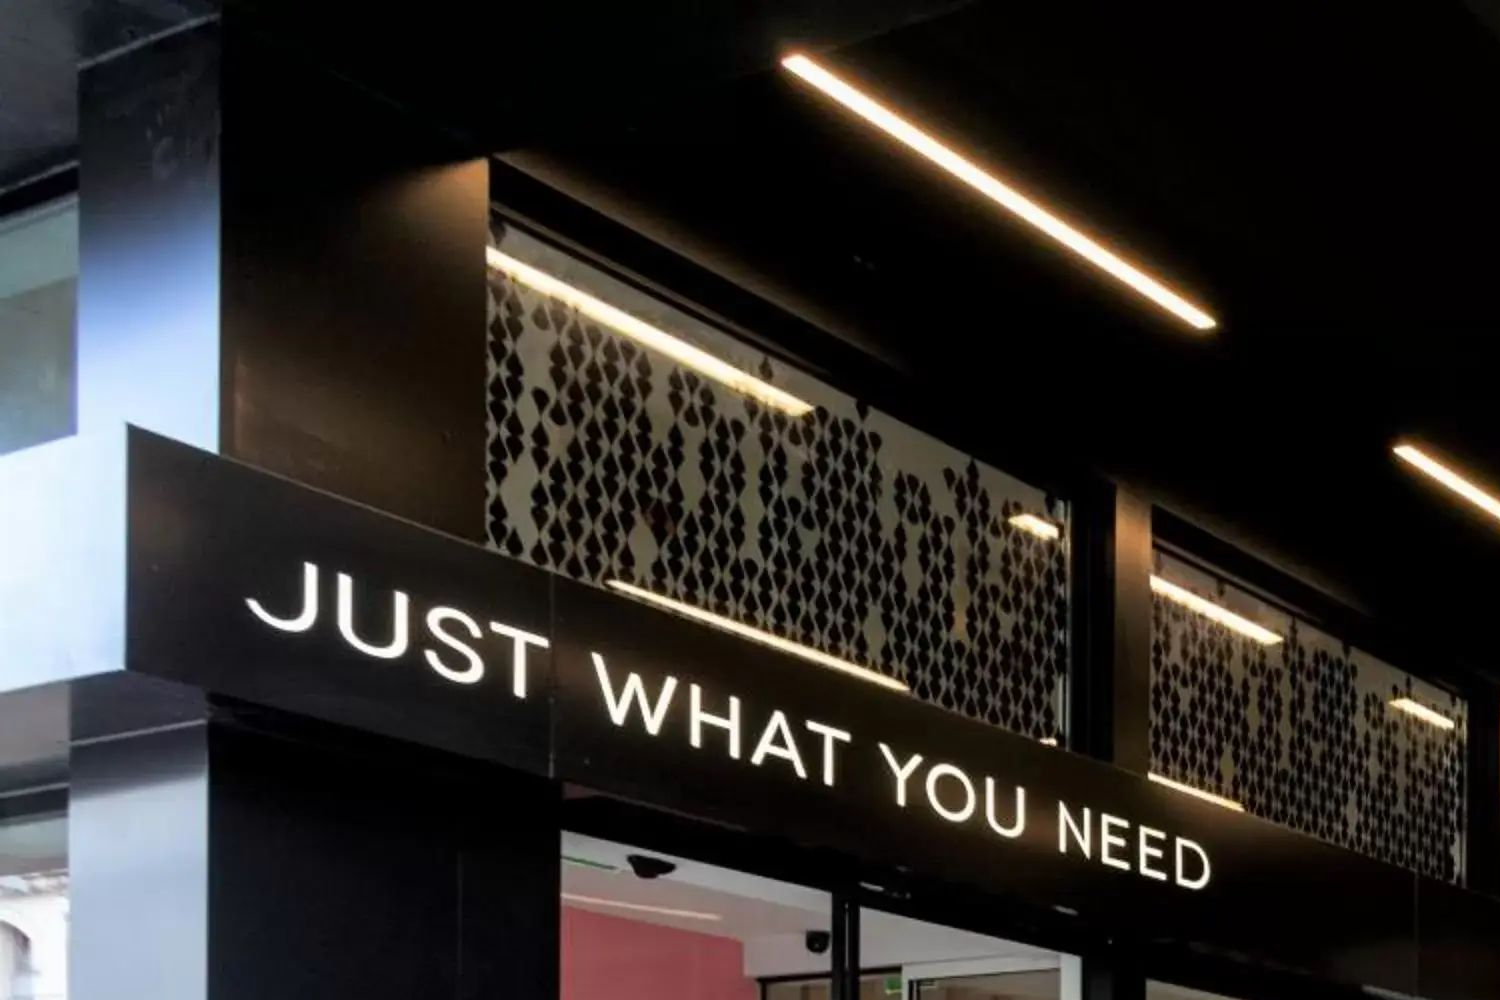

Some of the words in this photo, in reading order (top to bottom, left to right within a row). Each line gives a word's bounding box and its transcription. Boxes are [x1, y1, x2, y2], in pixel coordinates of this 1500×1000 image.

[245, 561, 550, 699] JUST
[591, 651, 851, 786] WHAT
[878, 742, 1026, 839] YOU
[1058, 800, 1211, 890] NEED
